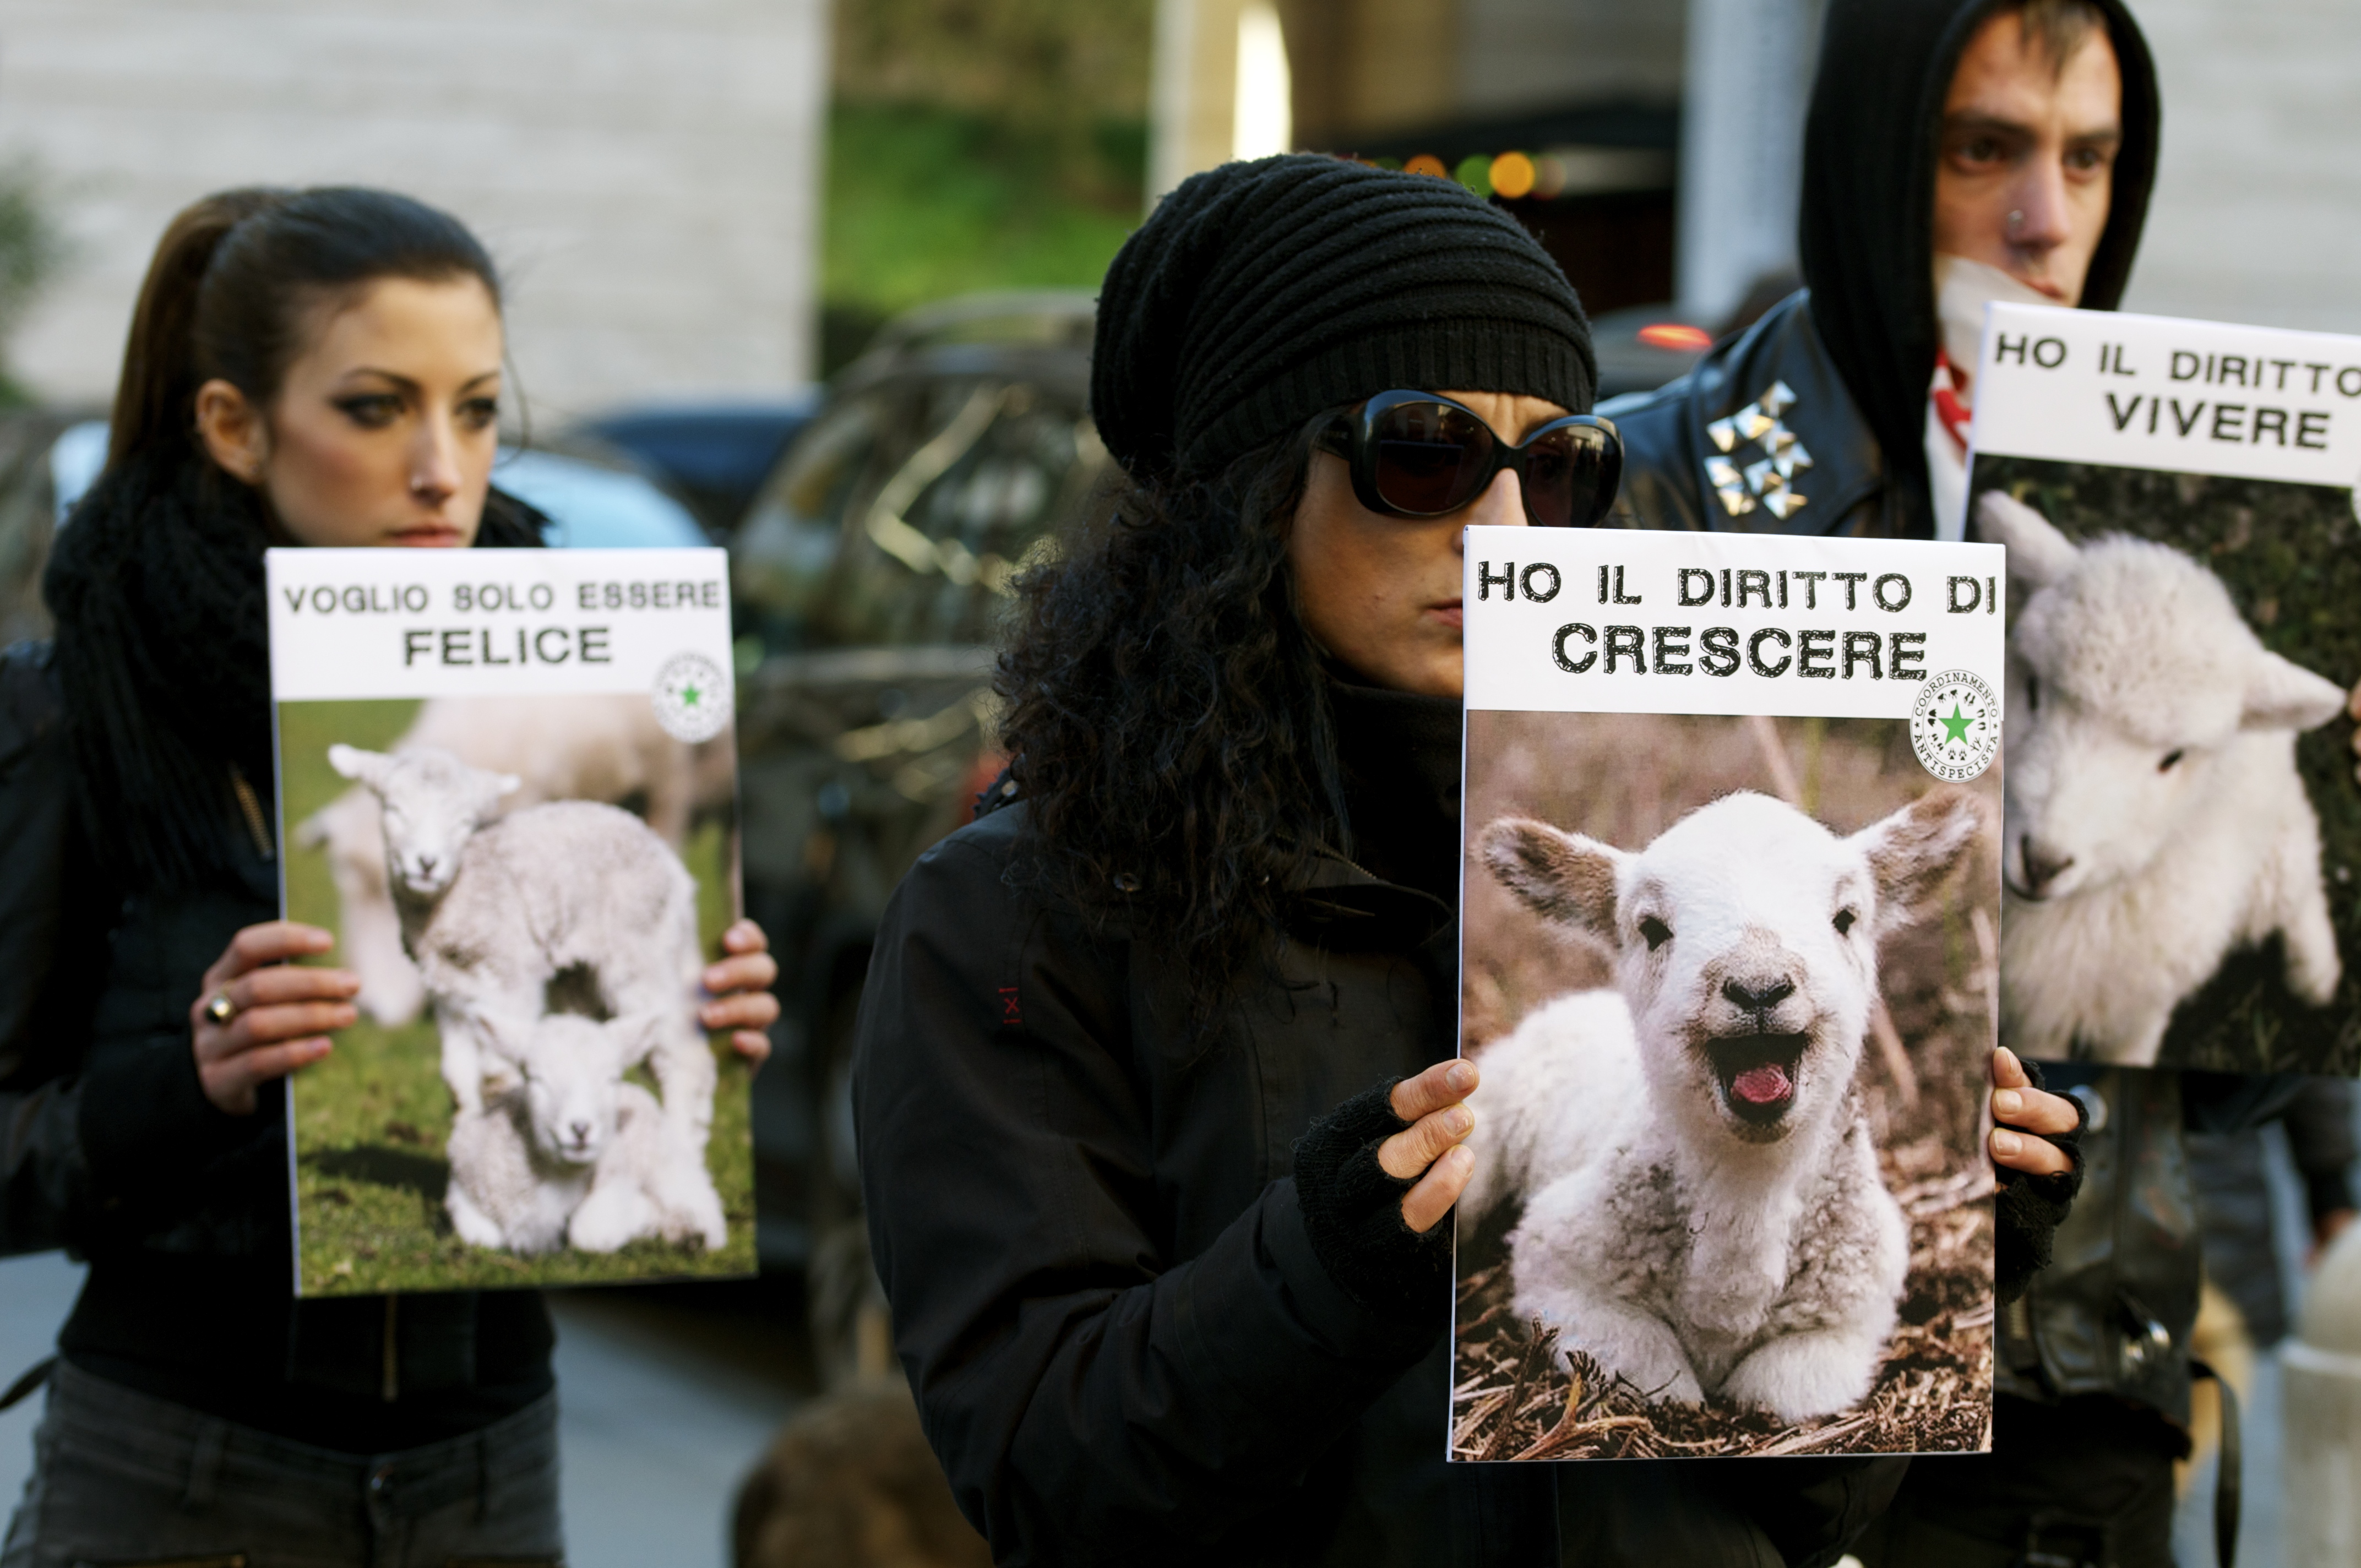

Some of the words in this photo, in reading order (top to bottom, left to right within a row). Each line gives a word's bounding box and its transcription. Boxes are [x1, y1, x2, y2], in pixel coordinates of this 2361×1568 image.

[1994, 332, 2068, 369] HO
[2098, 343, 2136, 377] IL
[2168, 350, 2361, 399] DIRITTO
[2106, 391, 2331, 450] VIVERE
[285, 584, 429, 613] VOGLIO
[453, 582, 554, 612] SOLO
[577, 580, 721, 609] ESSERE
[1478, 561, 1562, 603] HO
[1598, 564, 1642, 605] IL
[1678, 568, 1912, 613] DIRITTO
[1947, 576, 1996, 615] DI
[403, 627, 611, 666] FELICE
[1552, 622, 1927, 682] CRESCERE
[1915, 672, 1999, 717] COORDINAMENTO
[1914, 734, 1998, 779] ANTISPECISTA
